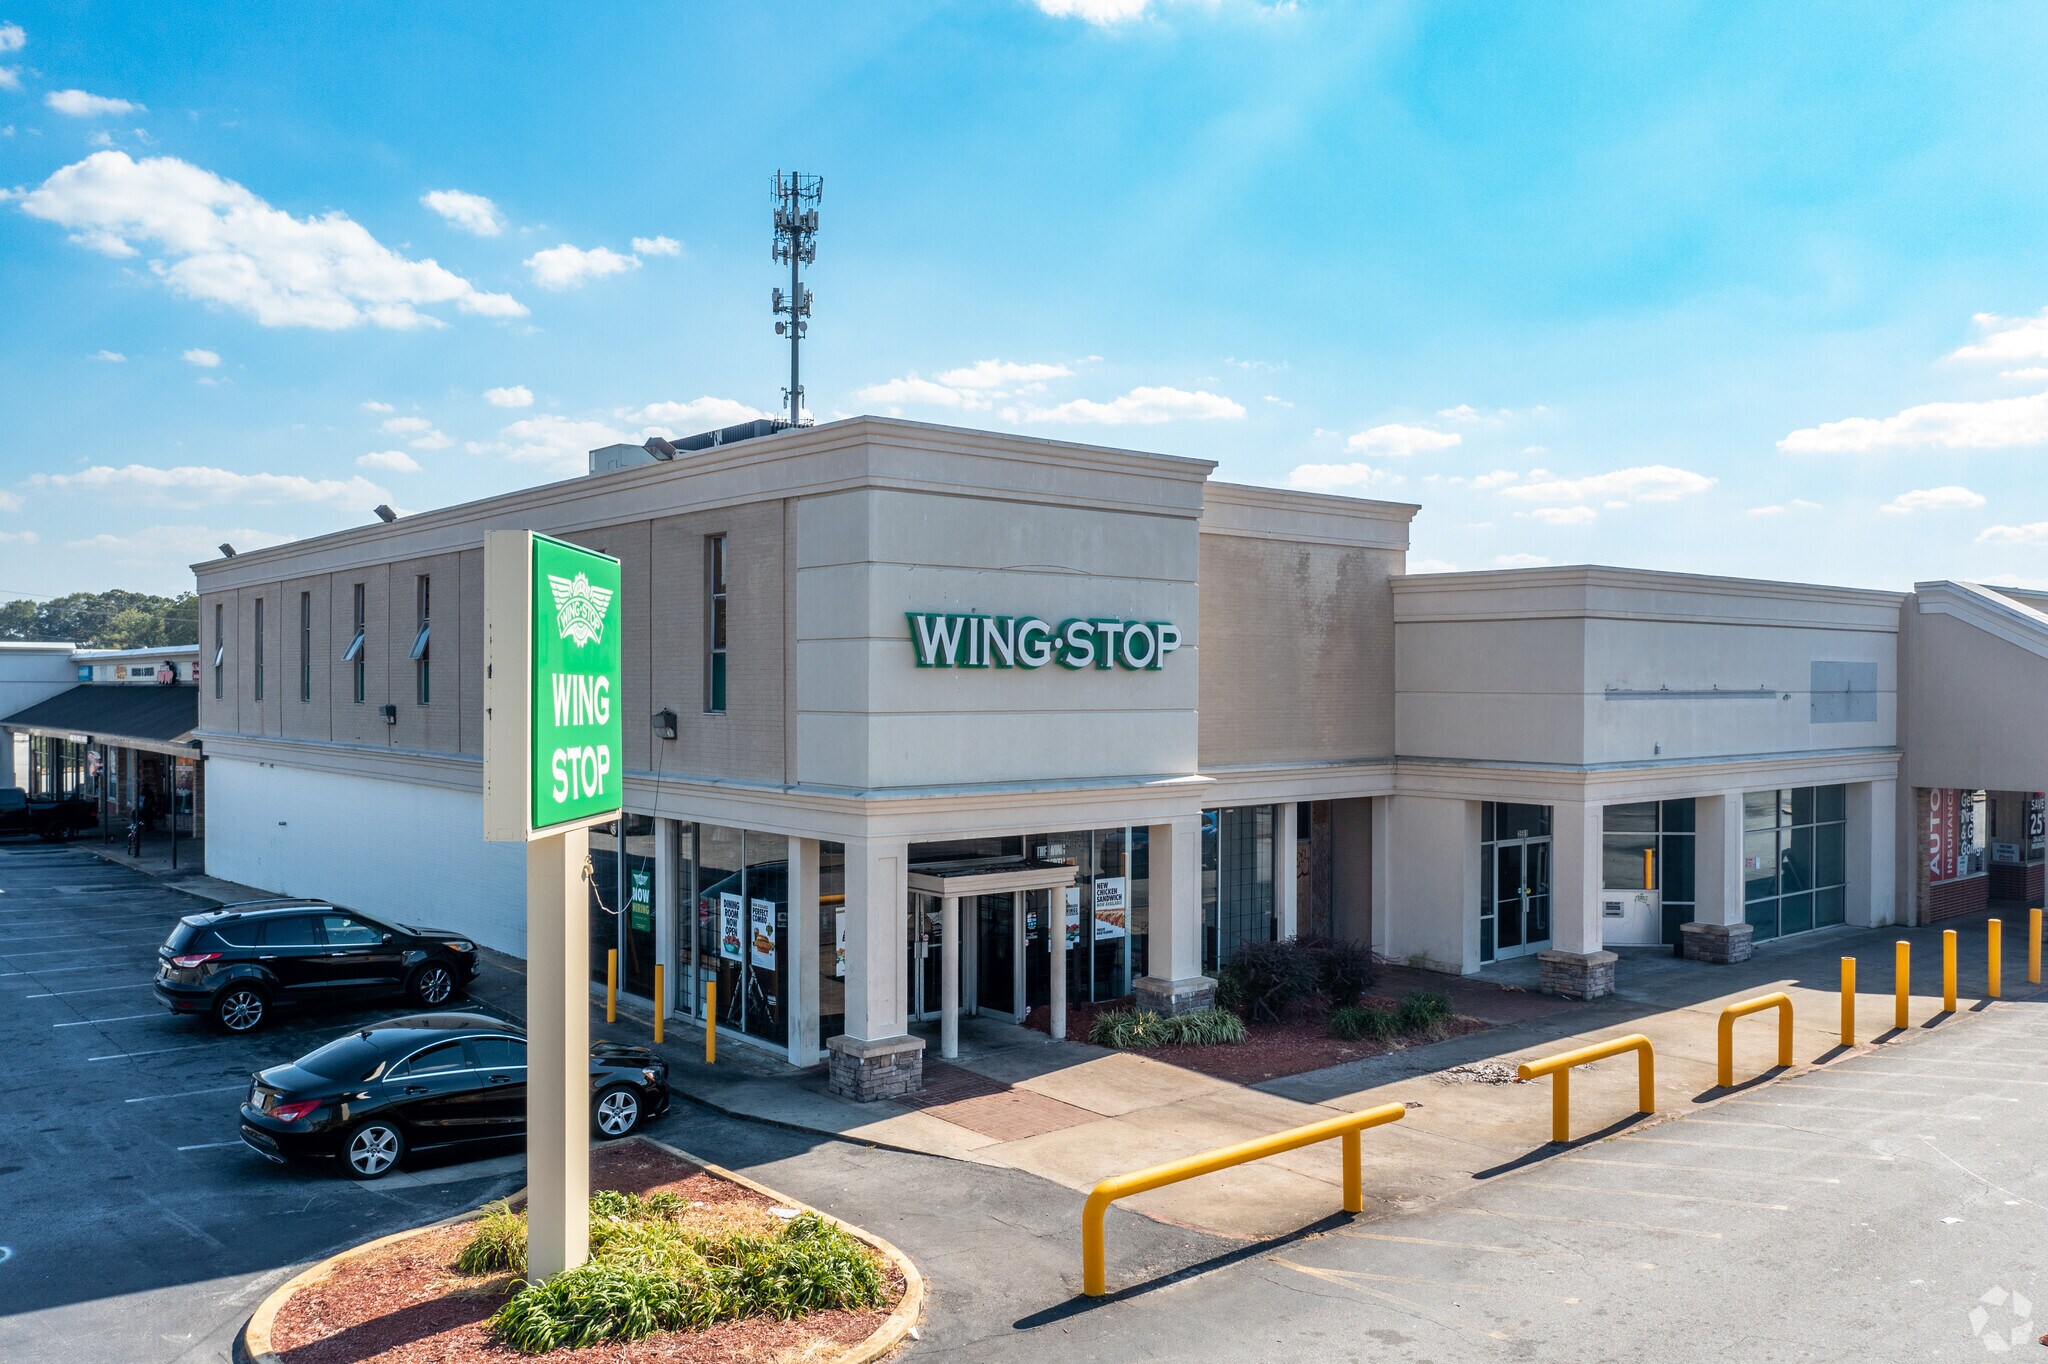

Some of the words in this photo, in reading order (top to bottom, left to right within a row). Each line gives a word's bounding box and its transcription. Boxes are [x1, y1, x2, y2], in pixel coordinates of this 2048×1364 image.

[552, 673, 610, 727] WING
[552, 744, 610, 803] STOP
[2031, 798, 2045, 811] SAVE
[1929, 788, 1941, 875] AUTO
[632, 887, 650, 903] NOW
[1096, 888, 1118, 896] CHICKEN
[1096, 894, 1122, 902] SANDWICH
[724, 899, 740, 910] DINING
[725, 908, 739, 919] ROOM
[752, 907, 768, 917] PERFECT
[726, 918, 738, 928] NOW
[752, 915, 767, 924] COMBO
[725, 926, 738, 936] OPEN
